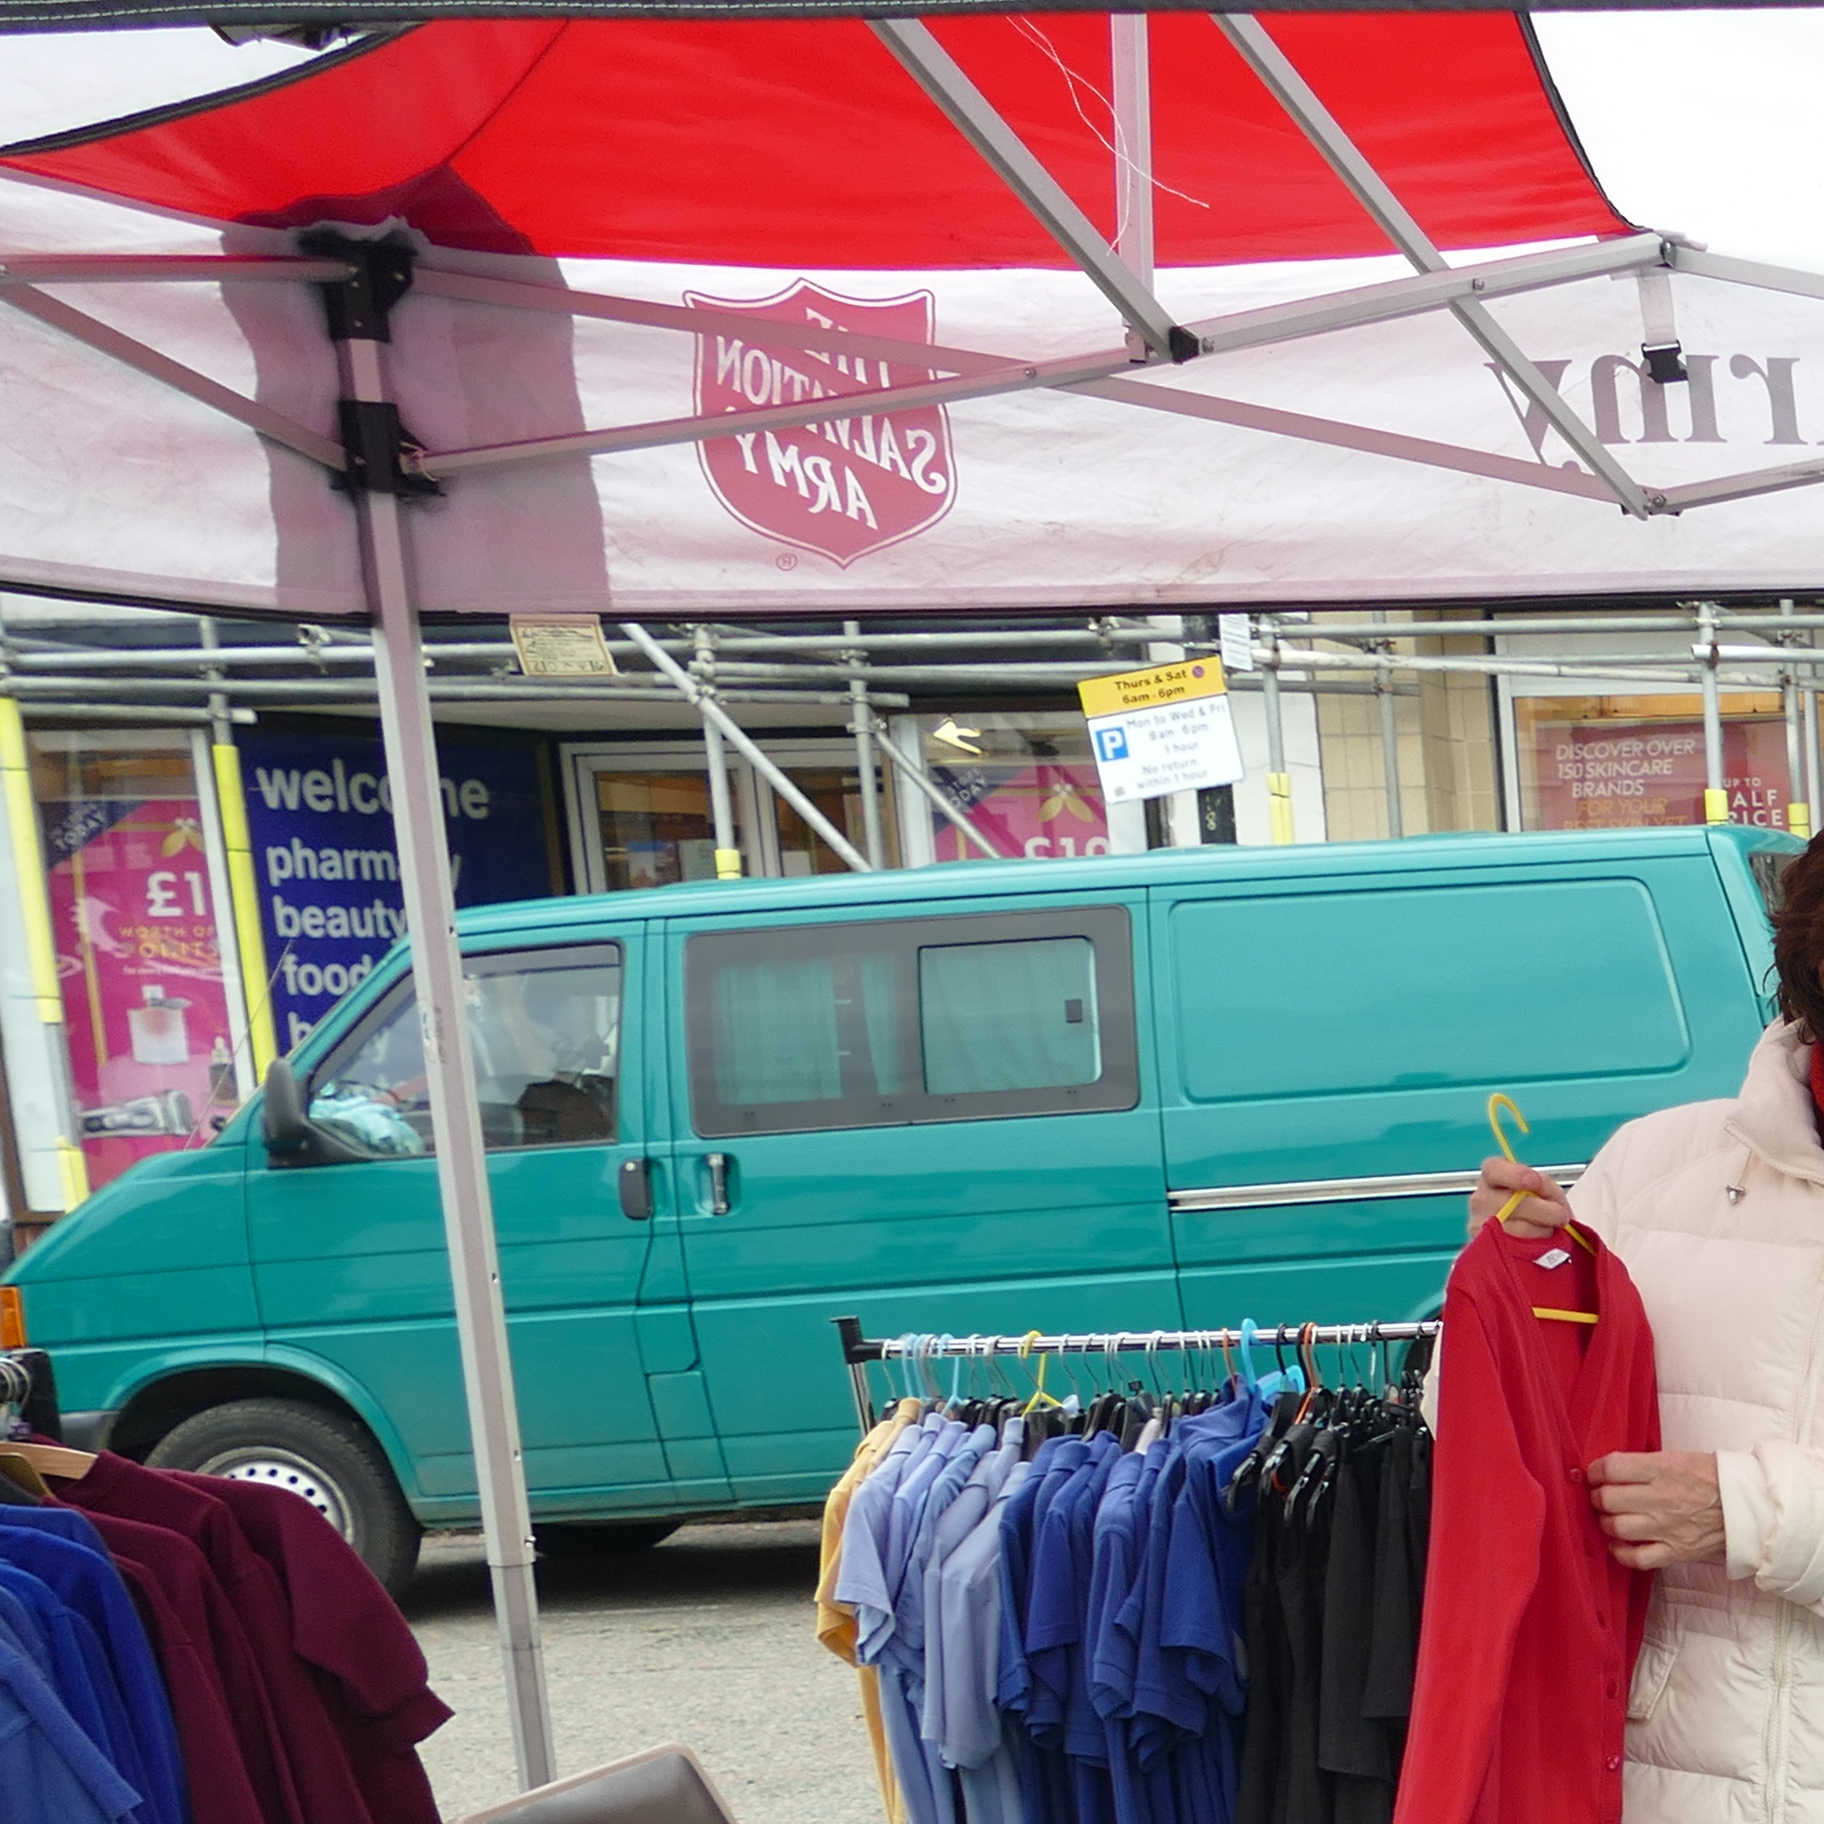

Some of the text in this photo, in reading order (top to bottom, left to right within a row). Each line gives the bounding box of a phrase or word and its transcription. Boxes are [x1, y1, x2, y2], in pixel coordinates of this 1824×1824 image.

[1114, 669, 1187, 691] Thurs & Sat
[1126, 718, 1150, 730] Mon
[1154, 715, 1166, 726] to
[1170, 709, 1195, 722] Wed
[1210, 702, 1226, 714] Fri
[1101, 728, 1123, 761] P
[1171, 741, 1199, 753] hour
[1556, 738, 1697, 761] DISCOVER OVER
[1558, 758, 1674, 780] 150 SKINCARE
[1572, 779, 1646, 799] BRANDS
[1723, 777, 1762, 788] UP TO
[1577, 797, 1670, 817] FOR YOUR
[1732, 789, 1778, 808] ALF
[1727, 808, 1784, 827] RICE
